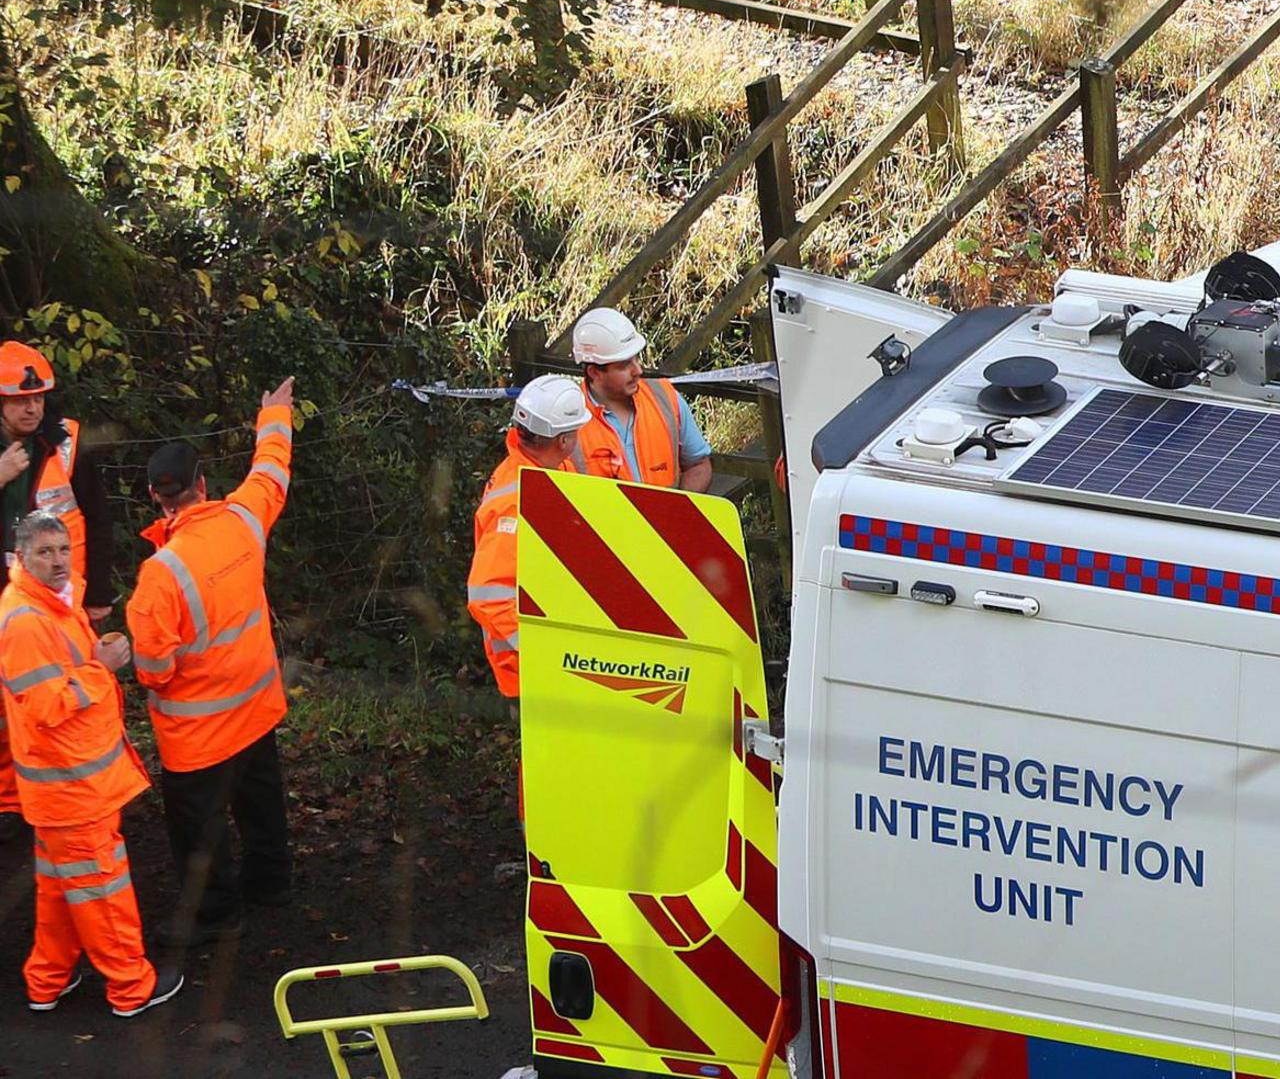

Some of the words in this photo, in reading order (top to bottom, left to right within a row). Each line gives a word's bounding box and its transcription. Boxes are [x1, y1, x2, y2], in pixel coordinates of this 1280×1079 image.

[562, 652, 691, 683] NetworkRail
[878, 735, 1184, 821] EMERGENCY
[853, 792, 1204, 888] INTERVENTION
[973, 873, 1084, 926] UNIT
